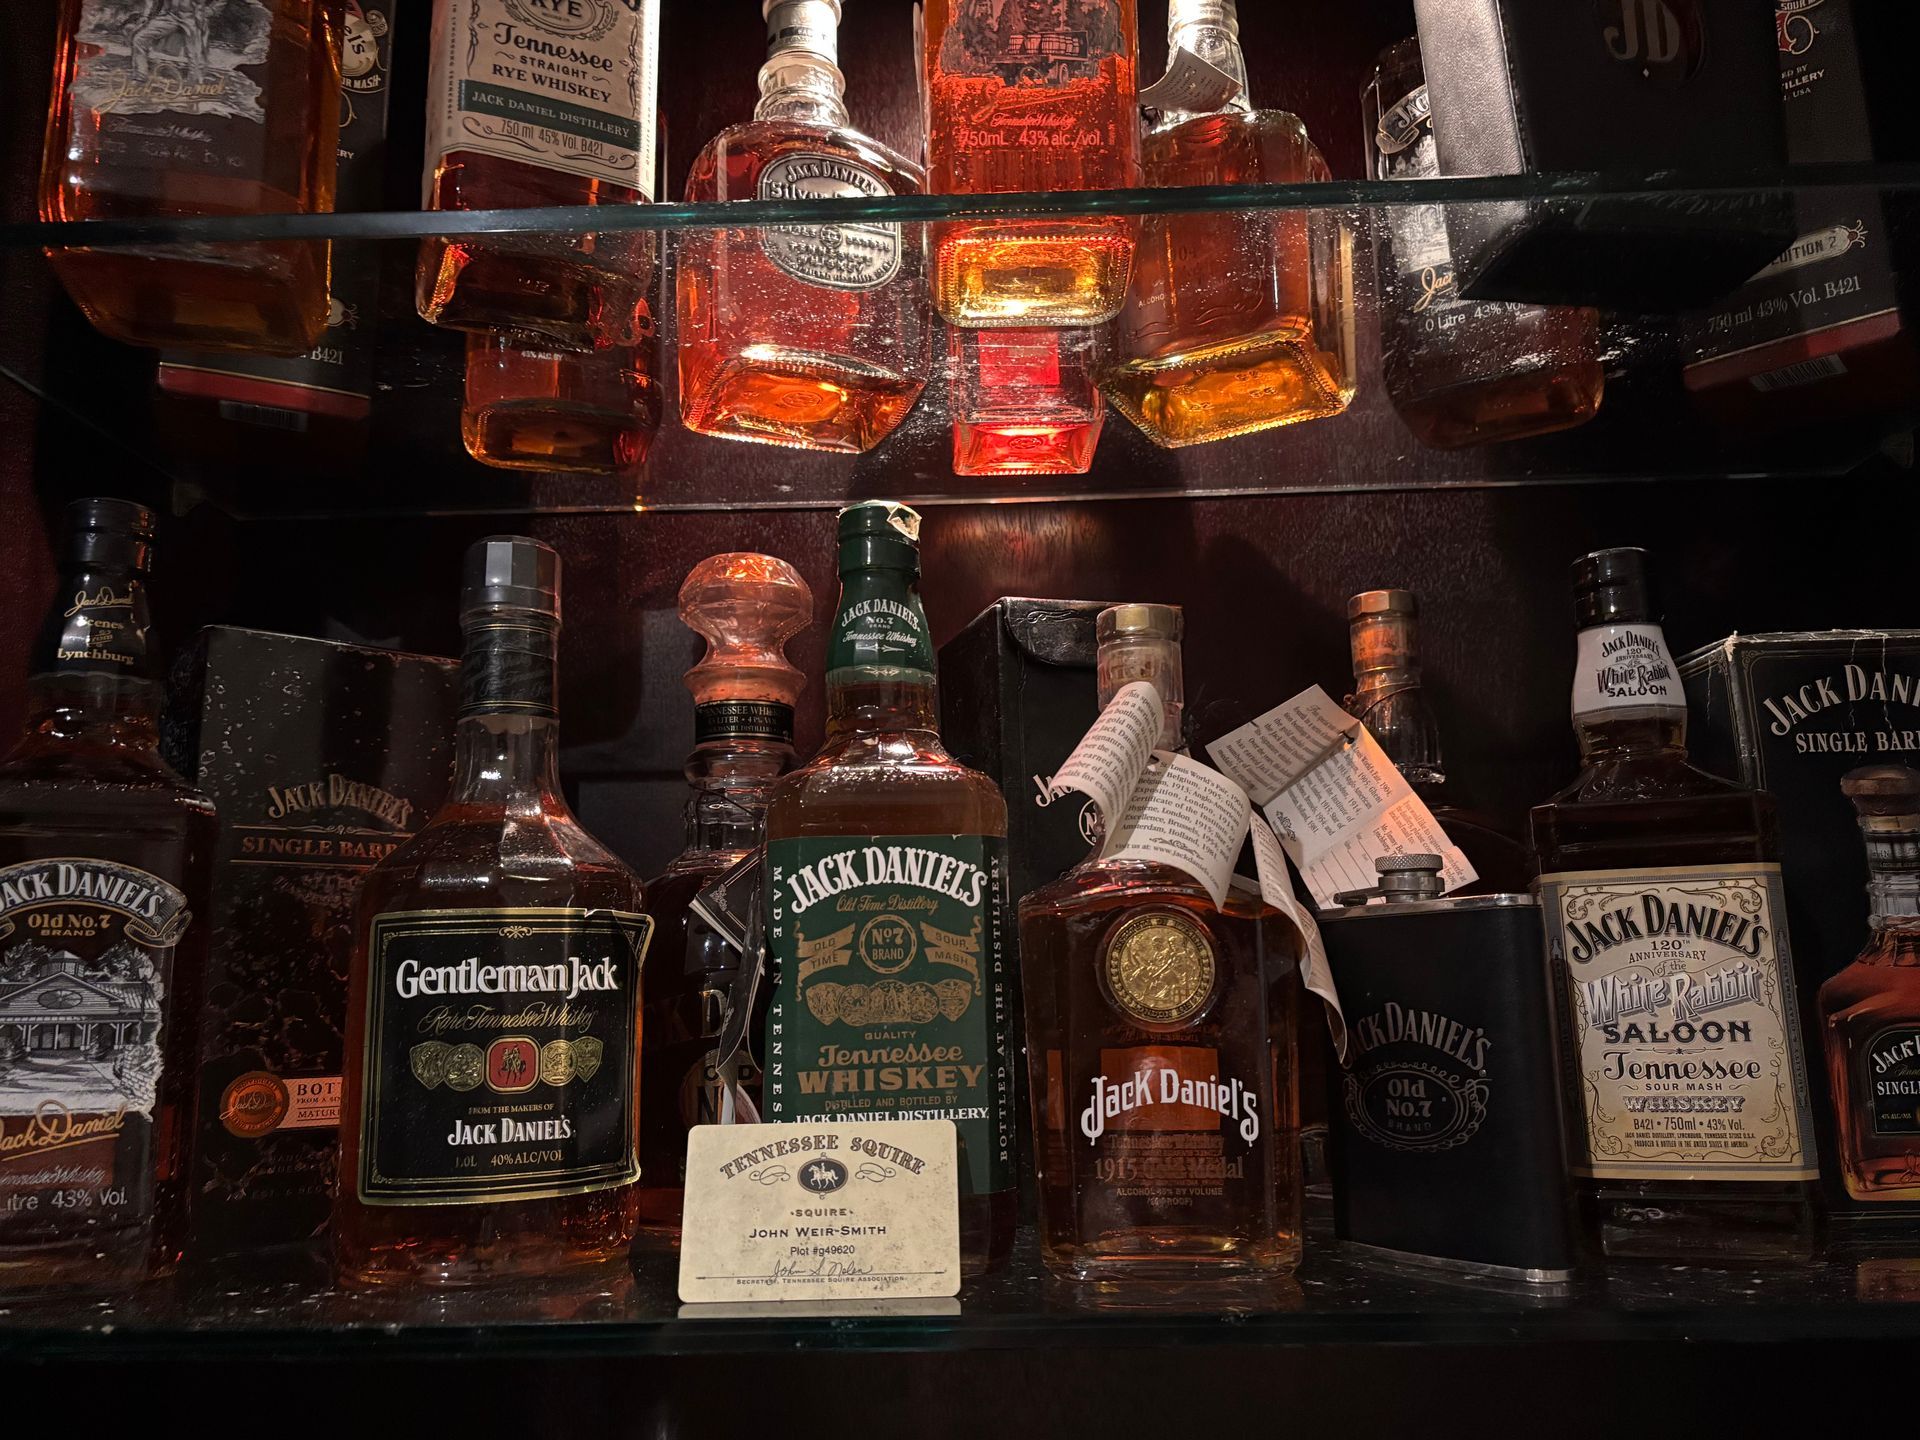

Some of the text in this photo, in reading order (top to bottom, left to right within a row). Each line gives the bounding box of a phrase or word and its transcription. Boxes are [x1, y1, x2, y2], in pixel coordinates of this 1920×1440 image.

[493, 22, 614, 73] Tennessee
[520, 55, 587, 79] STRAIGHT
[492, 63, 612, 103] RYE WHISKEY
[472, 91, 630, 138] JACK DANIEL DISTILLERY
[1397, 92, 1432, 128] JAC
[502, 119, 604, 157] 750 ml 45% Vol. B421
[962, 131, 1009, 147] 750mL
[1019, 130, 1048, 146] 43%
[786, 164, 820, 183] JACK
[1708, 275, 1862, 334] 750 ml 43% Vol. B421
[1438, 312, 1466, 329] Litre
[1474, 303, 1501, 319] 43%
[842, 599, 872, 627] JACK
[843, 630, 917, 647] Tennessee Whiskey
[1602, 636, 1626, 658] JACK
[57, 648, 134, 665] Lynchburg
[1596, 661, 1672, 694] White Rabbit
[1607, 685, 1668, 698] SALOON
[1763, 664, 1920, 736] JACK DANI
[1795, 731, 1869, 753] SINGLE
[1171, 764, 1188, 775] Louis
[1167, 772, 1200, 790] Belgium,
[268, 781, 326, 819] JACK
[1185, 796, 1216, 816] London,
[1185, 805, 1198, 814] the
[1162, 807, 1192, 823] London,
[242, 836, 333, 856] SINGLE
[787, 846, 989, 914] JACK DANIEL'S
[0, 871, 54, 913] ACK
[836, 893, 939, 915] Old Time Distillery
[28, 913, 63, 928] Old
[1566, 894, 1769, 965] JACK DANIEL'S
[40, 929, 96, 937] BRAND
[814, 937, 837, 951] OLD
[810, 953, 840, 970] TIME
[872, 947, 905, 961] BRAND
[934, 951, 969, 966] MASH
[1629, 949, 1707, 964] ANNIVERSARY
[396, 956, 619, 1000] Gentleman Jack
[1653, 959, 1687, 977] of the
[772, 866, 783, 1123] MADE IN TENNES
[1581, 971, 1668, 1031] White
[1668, 960, 1766, 1023] Rabbit
[990, 855, 1008, 1162] BOTTLED AT THE DISTILLERY
[865, 1031, 917, 1041] QUALITY
[1384, 1002, 1492, 1071] DANIEL'S
[1603, 1021, 1752, 1044] SALOON
[818, 1043, 964, 1068] Tennessee
[1603, 1051, 1762, 1080] Tennessee
[1872, 1040, 1914, 1074] JACK
[796, 1064, 985, 1095] WHISKEY
[1388, 1079, 1426, 1098] Old
[1645, 1082, 1724, 1092] SOUR MASH
[511, 1104, 543, 1113] MAKERS
[825, 1095, 958, 1112] DISTILLED AND BOTTLED BY
[1160, 1068, 1259, 1147] Daniel's
[1623, 1094, 1746, 1113] WHISKEY
[36, 1099, 128, 1145] Daniel
[793, 1113, 831, 1124] JACK
[836, 1112, 895, 1123] DANIEL
[1388, 1121, 1432, 1132] BRAND
[1634, 1116, 1745, 1131] B421 750ml 43% Vol.
[447, 1115, 571, 1146] JACK DANIEL'S
[491, 1153, 513, 1167] 40%
[514, 1150, 564, 1165] ALC/VOL
[719, 1134, 926, 1180] TENNESSEE SQUIRE
[1095, 1158, 1137, 1183] 1915
[51, 1186, 128, 1209] 43% Vol.
[1116, 1187, 1223, 1196] ALCOHOL BY VOLUME
[749, 1226, 886, 1239] JOHN WEIR-SMITH
[790, 1245, 856, 1258] Plot #g49620
[858, 1275, 904, 1283] ASSOCIATION
